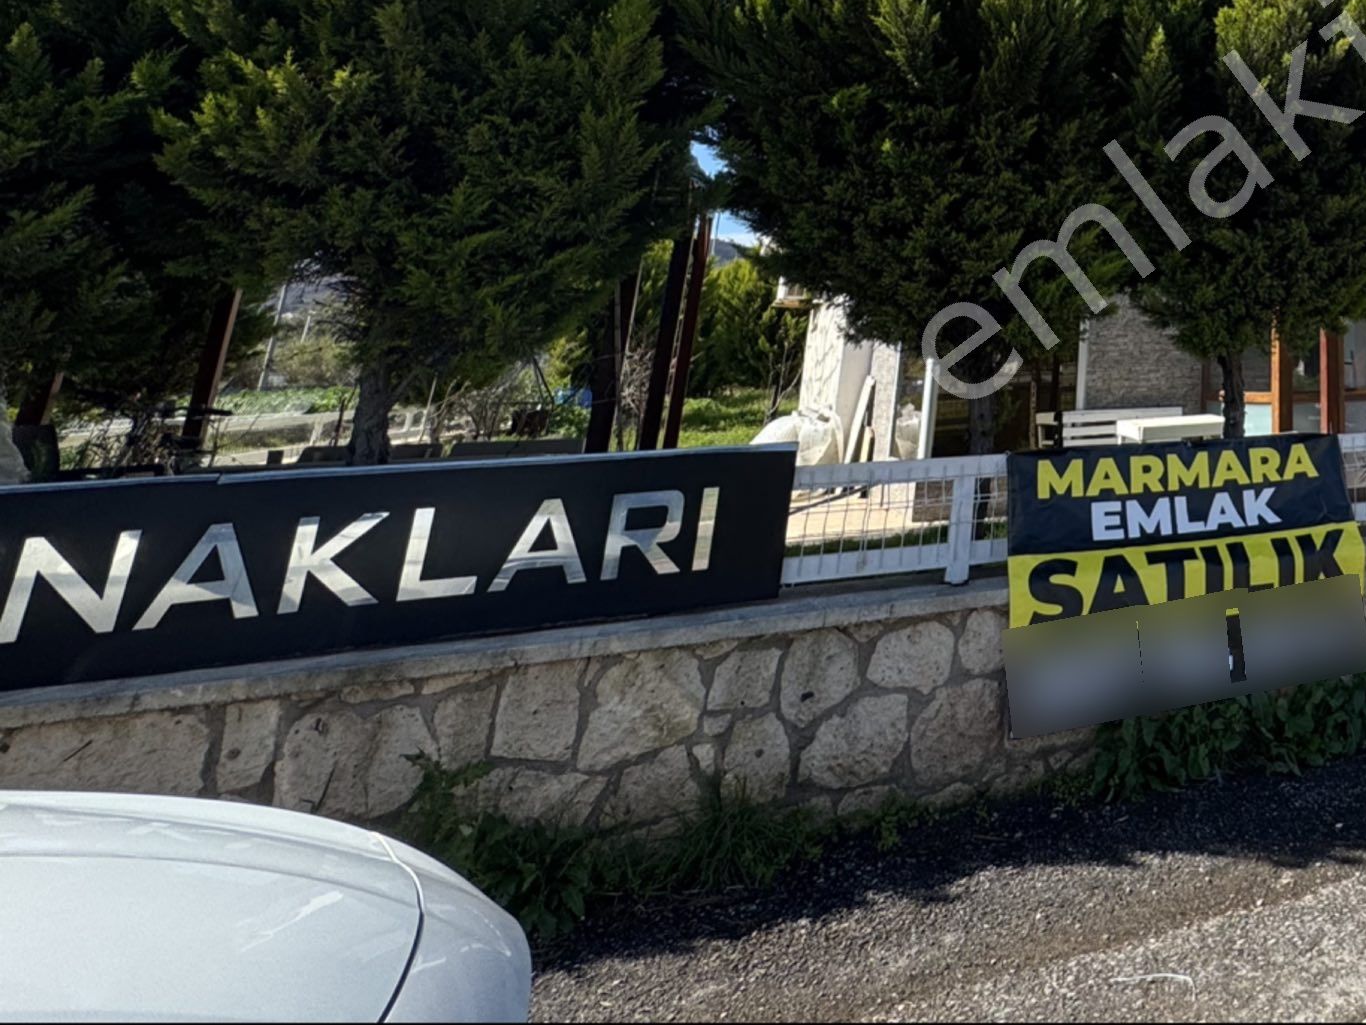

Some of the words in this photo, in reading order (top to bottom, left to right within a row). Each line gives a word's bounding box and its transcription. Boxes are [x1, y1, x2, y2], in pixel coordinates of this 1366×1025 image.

[1036, 443, 1319, 500] MARMARA
[1090, 487, 1282, 541] EMLAK
[0, 486, 719, 645] NAKLARI
[1028, 529, 1345, 626] SATILIK
